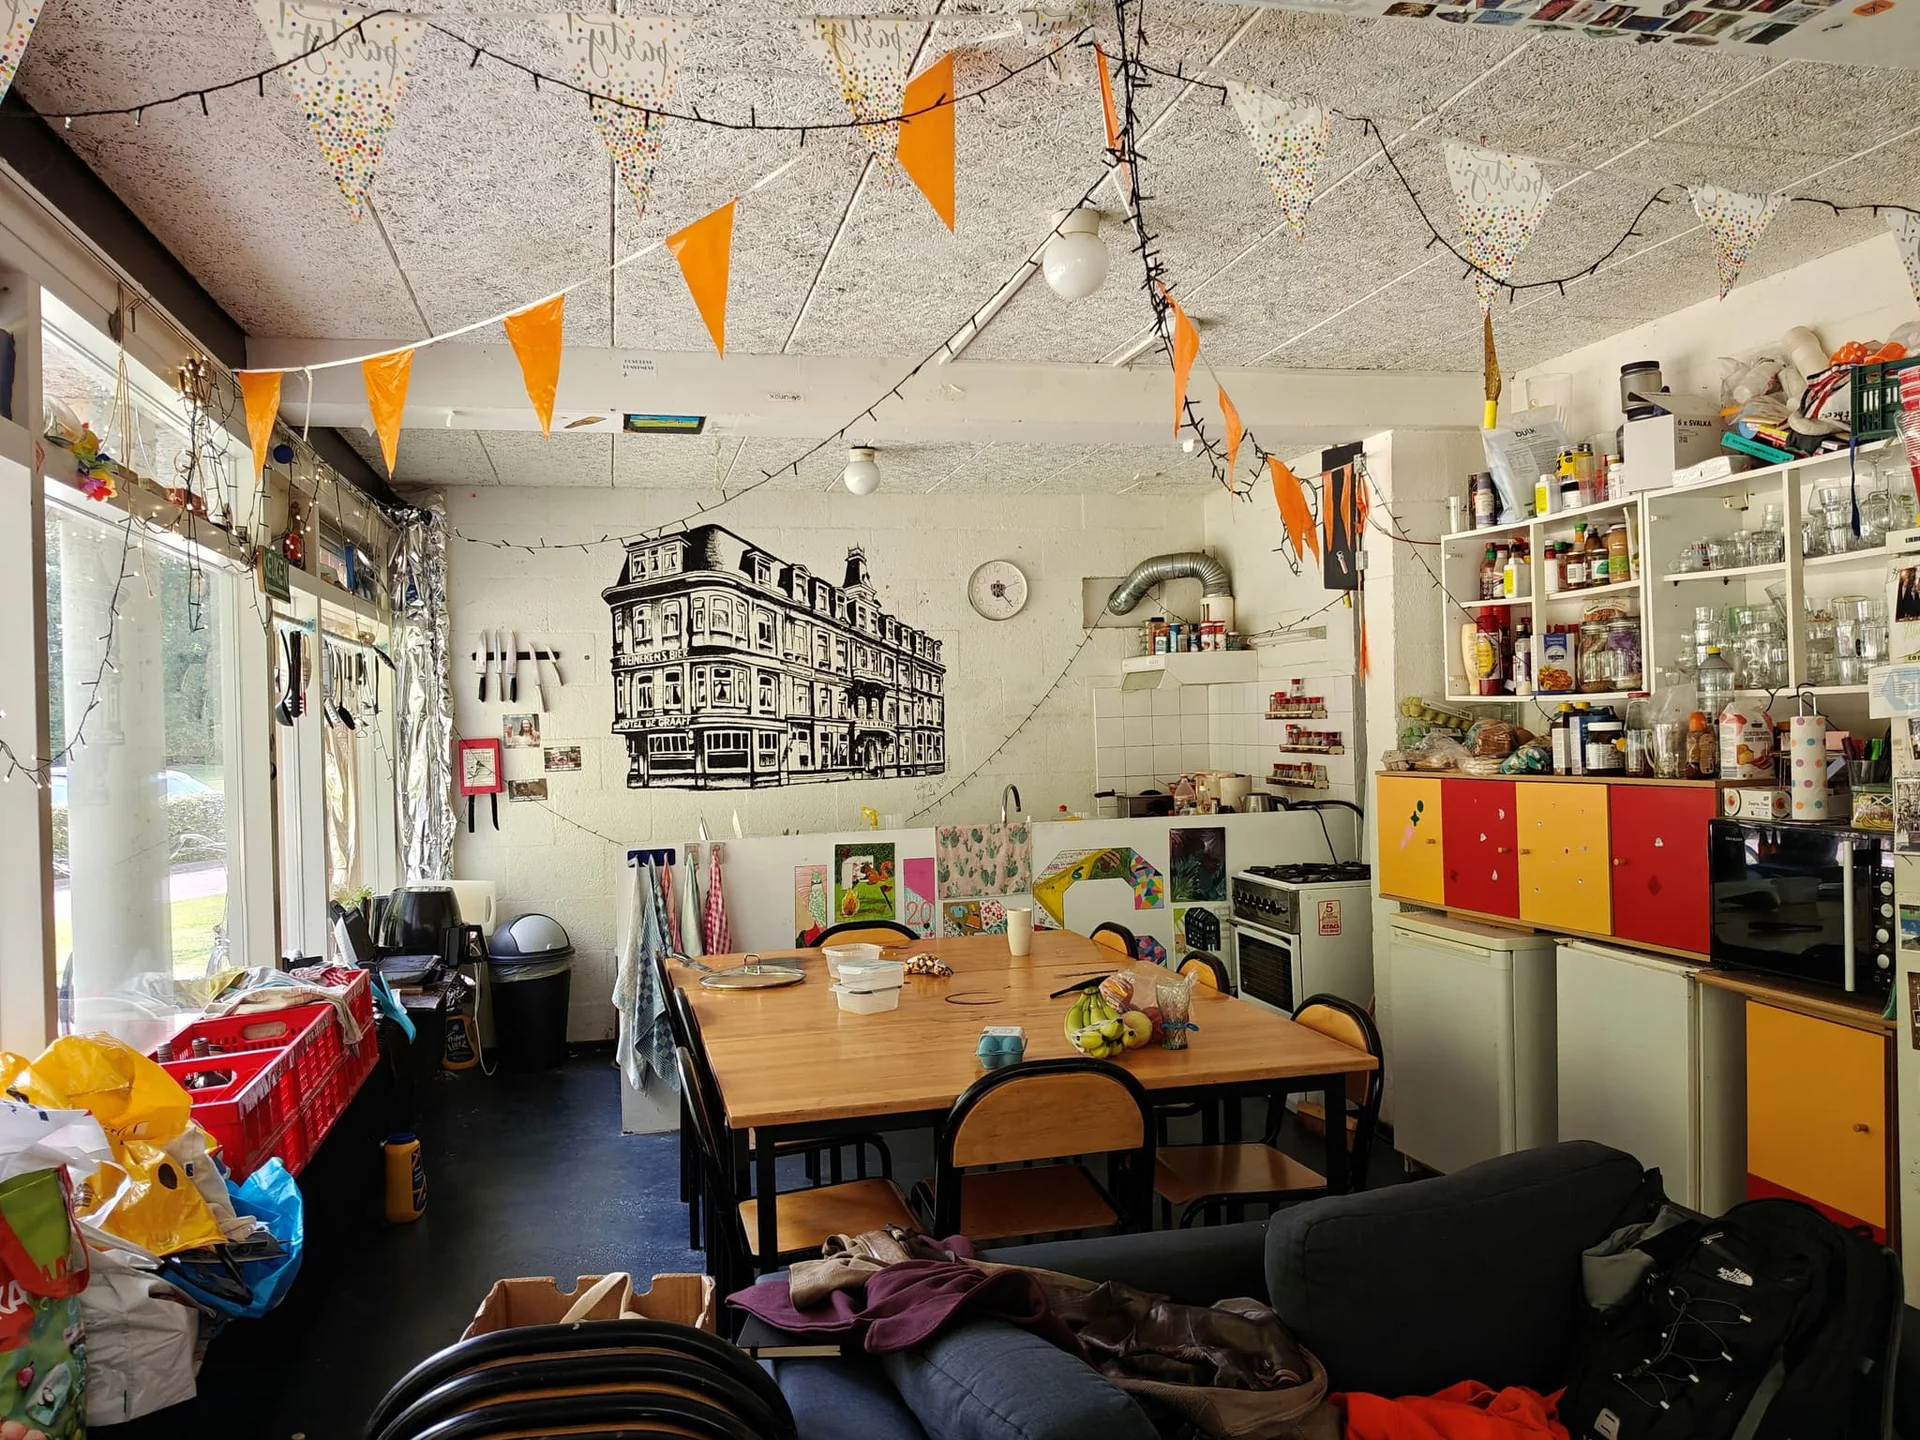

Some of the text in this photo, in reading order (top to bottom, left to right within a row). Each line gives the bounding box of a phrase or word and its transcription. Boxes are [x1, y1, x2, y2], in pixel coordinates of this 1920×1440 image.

[1689, 419, 1712, 428] SVALKA
[1514, 427, 1537, 438] bulk
[619, 715, 692, 730] HOTEL DE GRAAFF
[905, 900, 932, 926] 20
[1325, 902, 1334, 913] 5
